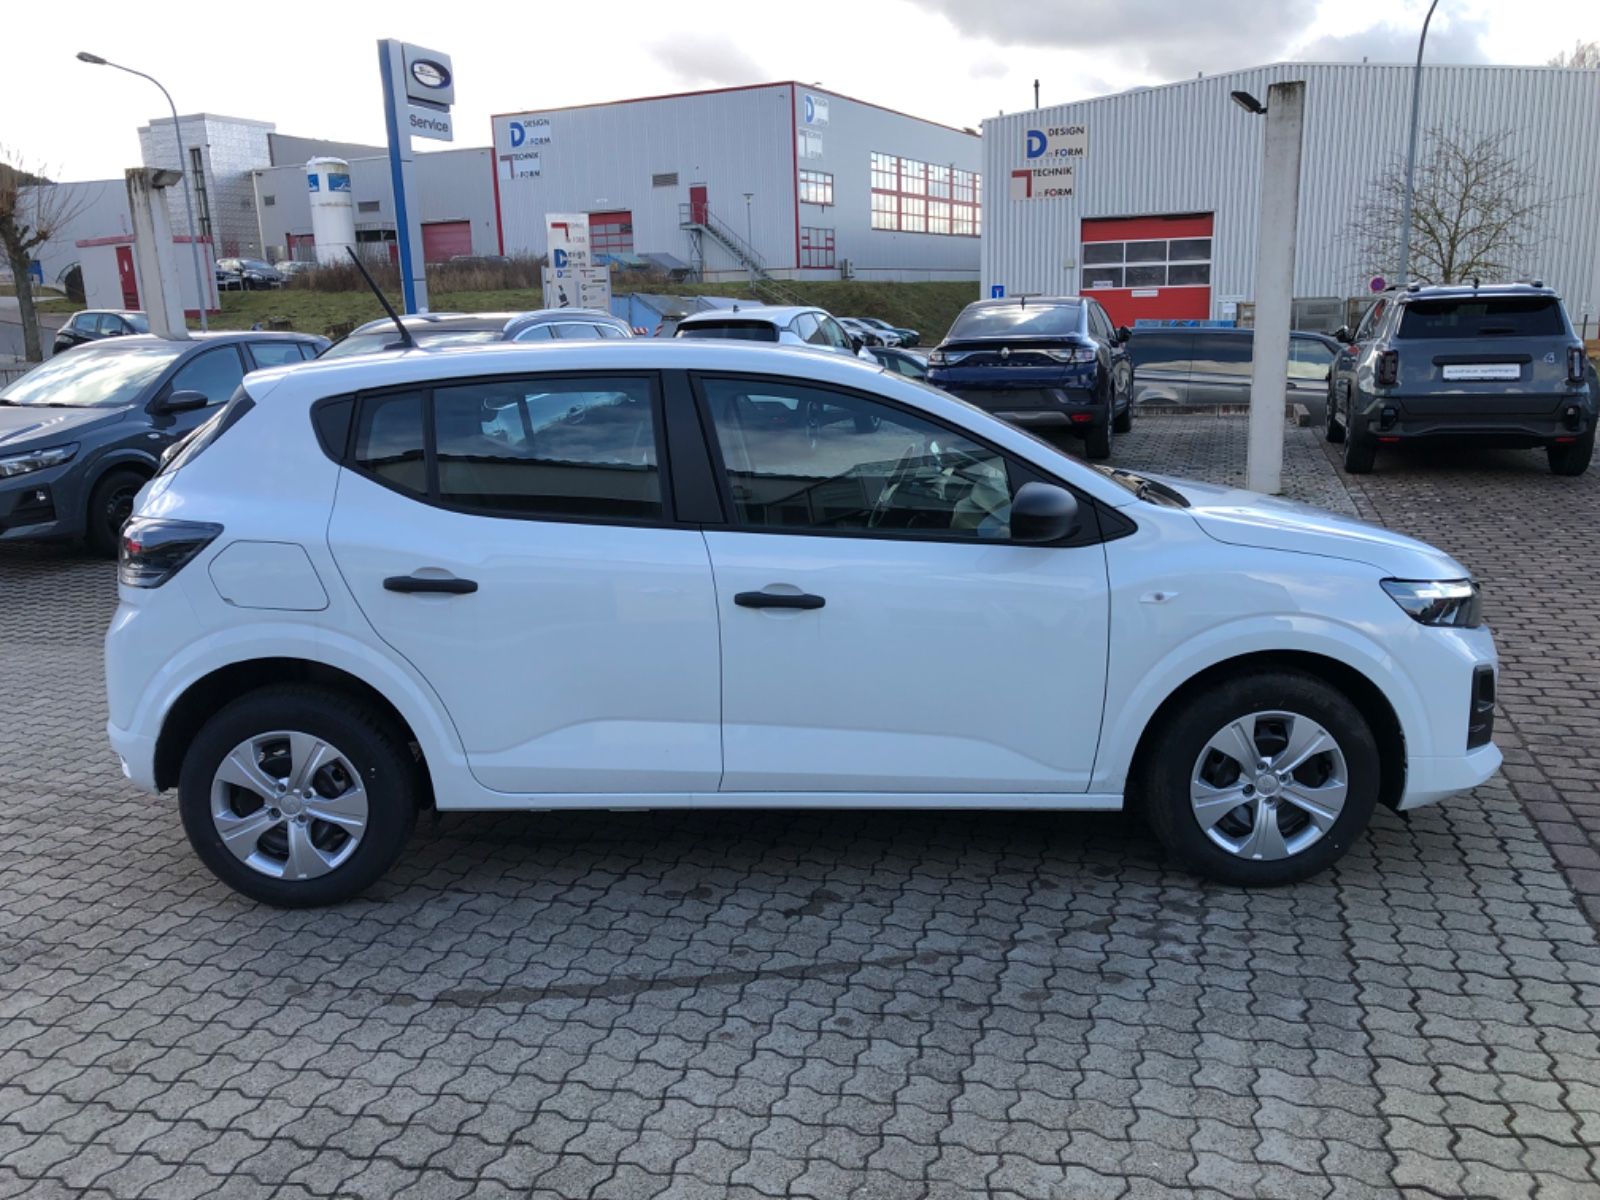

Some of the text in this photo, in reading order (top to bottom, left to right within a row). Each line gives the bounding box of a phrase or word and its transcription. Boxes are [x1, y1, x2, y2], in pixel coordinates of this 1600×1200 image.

[409, 114, 448, 133] Service
[1048, 126, 1085, 137] DESIGN
[1055, 148, 1083, 157] FORM
[1033, 166, 1072, 177] TECHNIK
[1044, 188, 1072, 198] FORM
